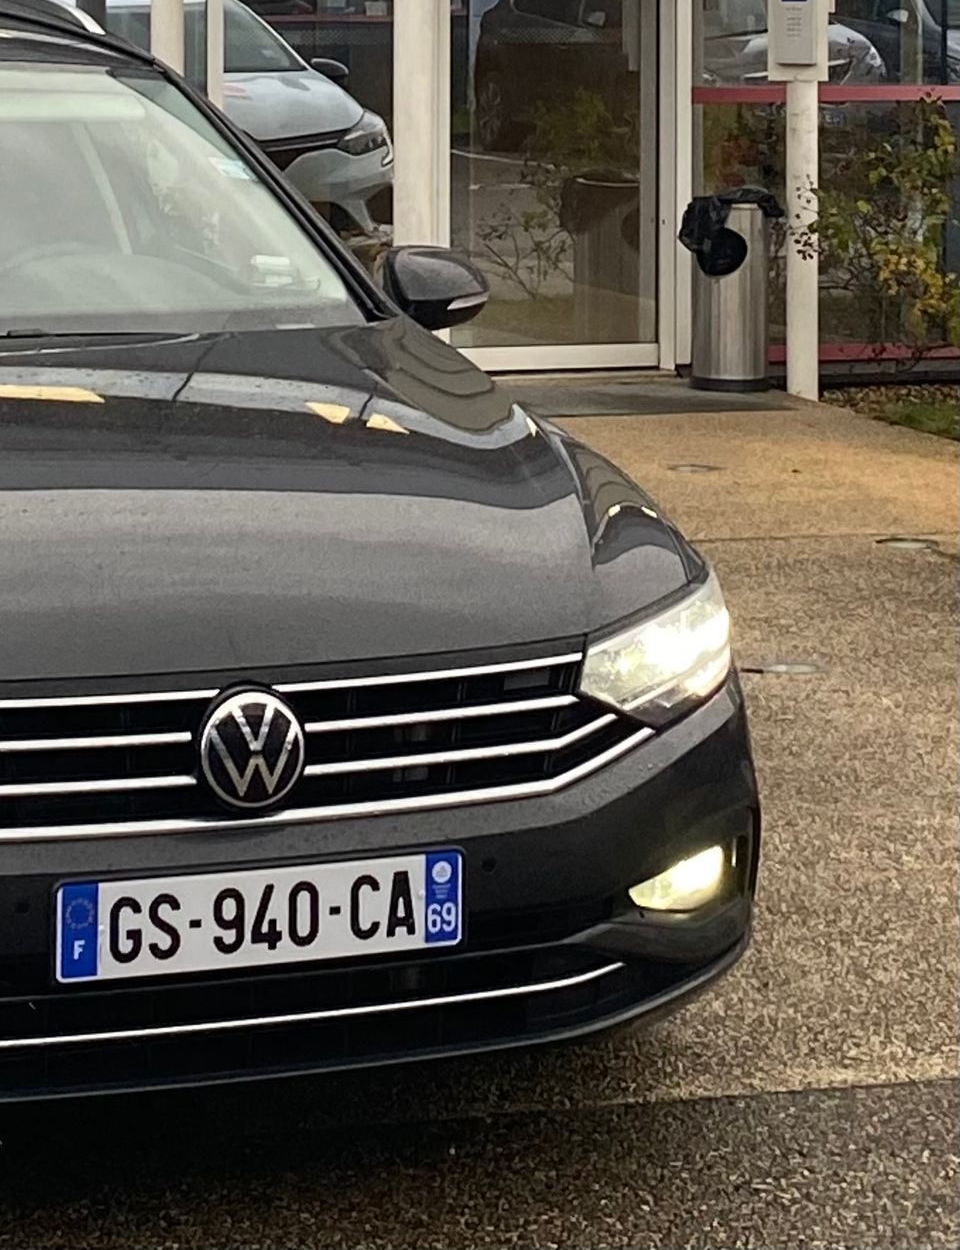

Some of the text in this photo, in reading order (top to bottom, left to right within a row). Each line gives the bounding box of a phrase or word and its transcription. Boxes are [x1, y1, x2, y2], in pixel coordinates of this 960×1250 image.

[109, 870, 416, 964] GS-940-CA
[427, 901, 456, 934] 69
[73, 940, 85, 960] F
